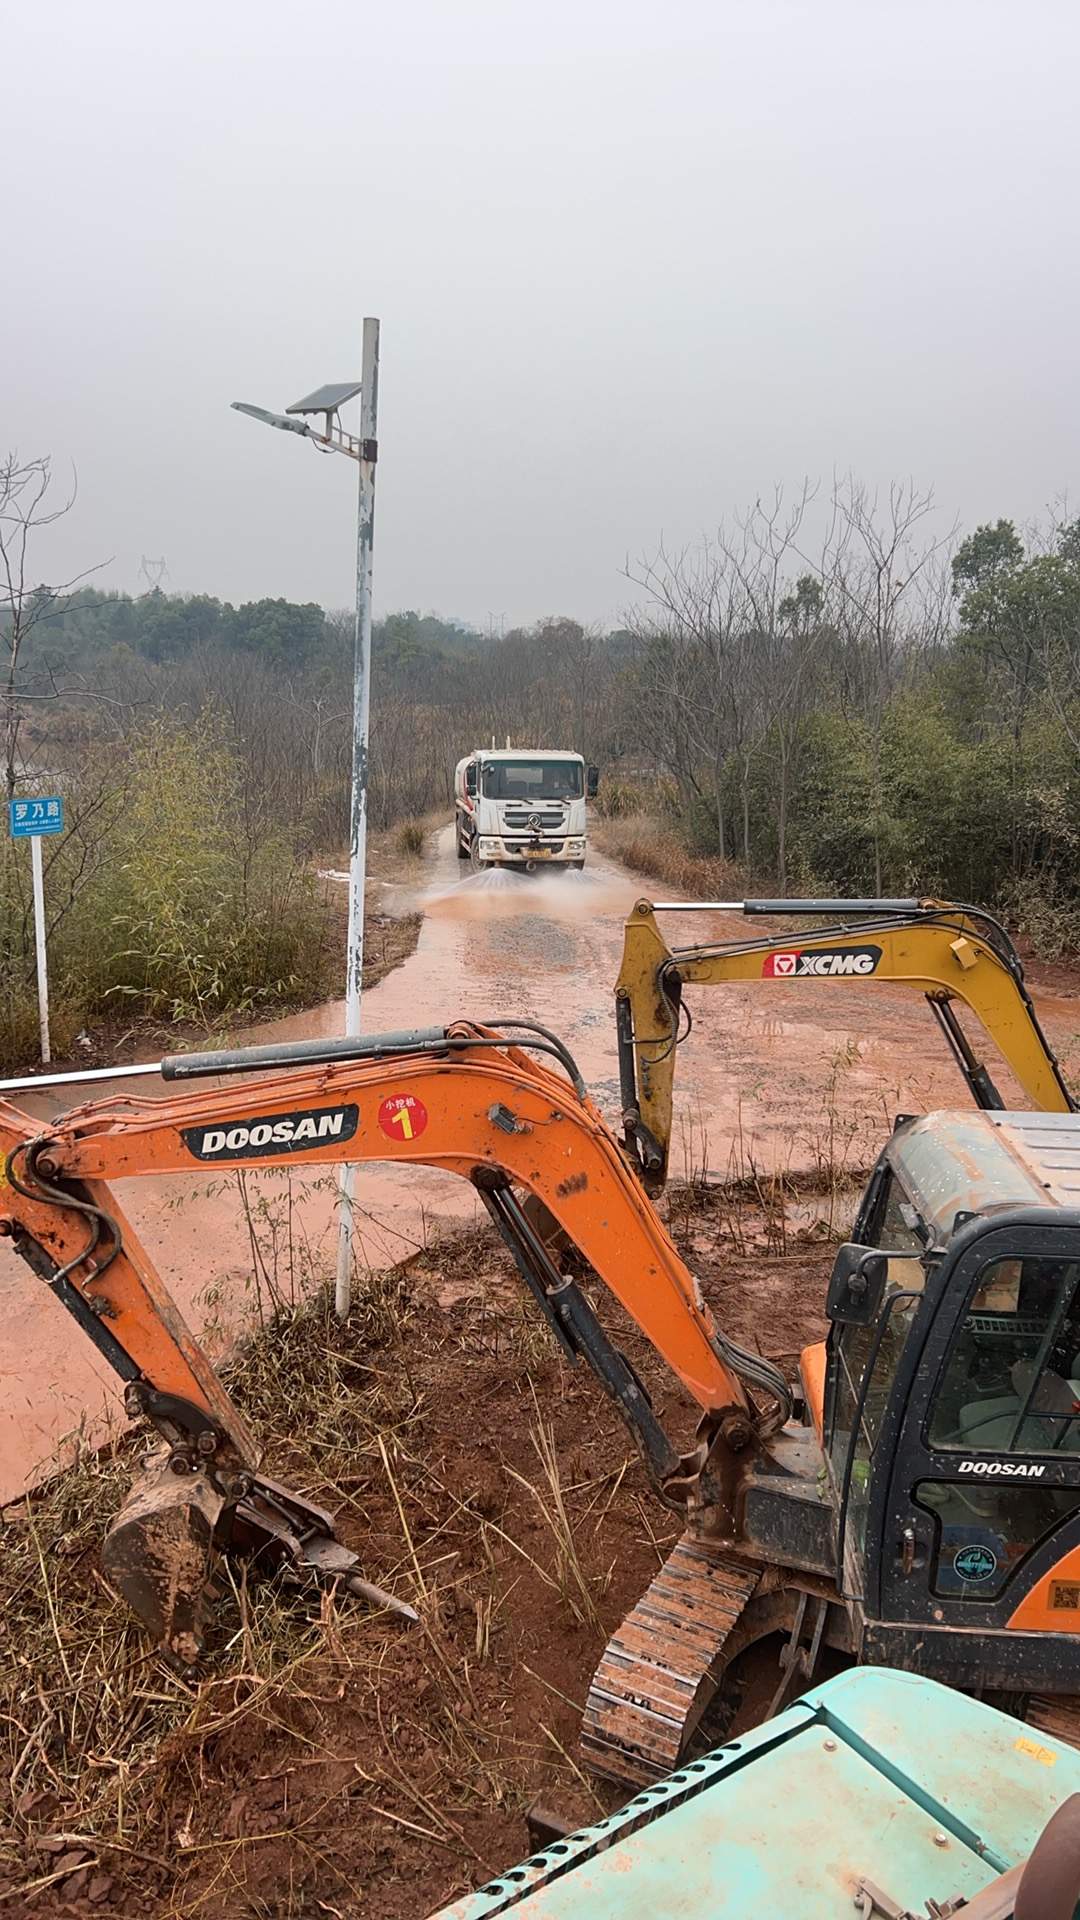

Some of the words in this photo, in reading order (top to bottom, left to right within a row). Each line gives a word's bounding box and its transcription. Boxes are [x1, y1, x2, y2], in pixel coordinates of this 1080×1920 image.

[796, 954, 874, 975] XCMG
[202, 1113, 344, 1153] DOOSAN
[391, 1107, 414, 1139] 1
[958, 1461, 1046, 1477] DOOSAN
